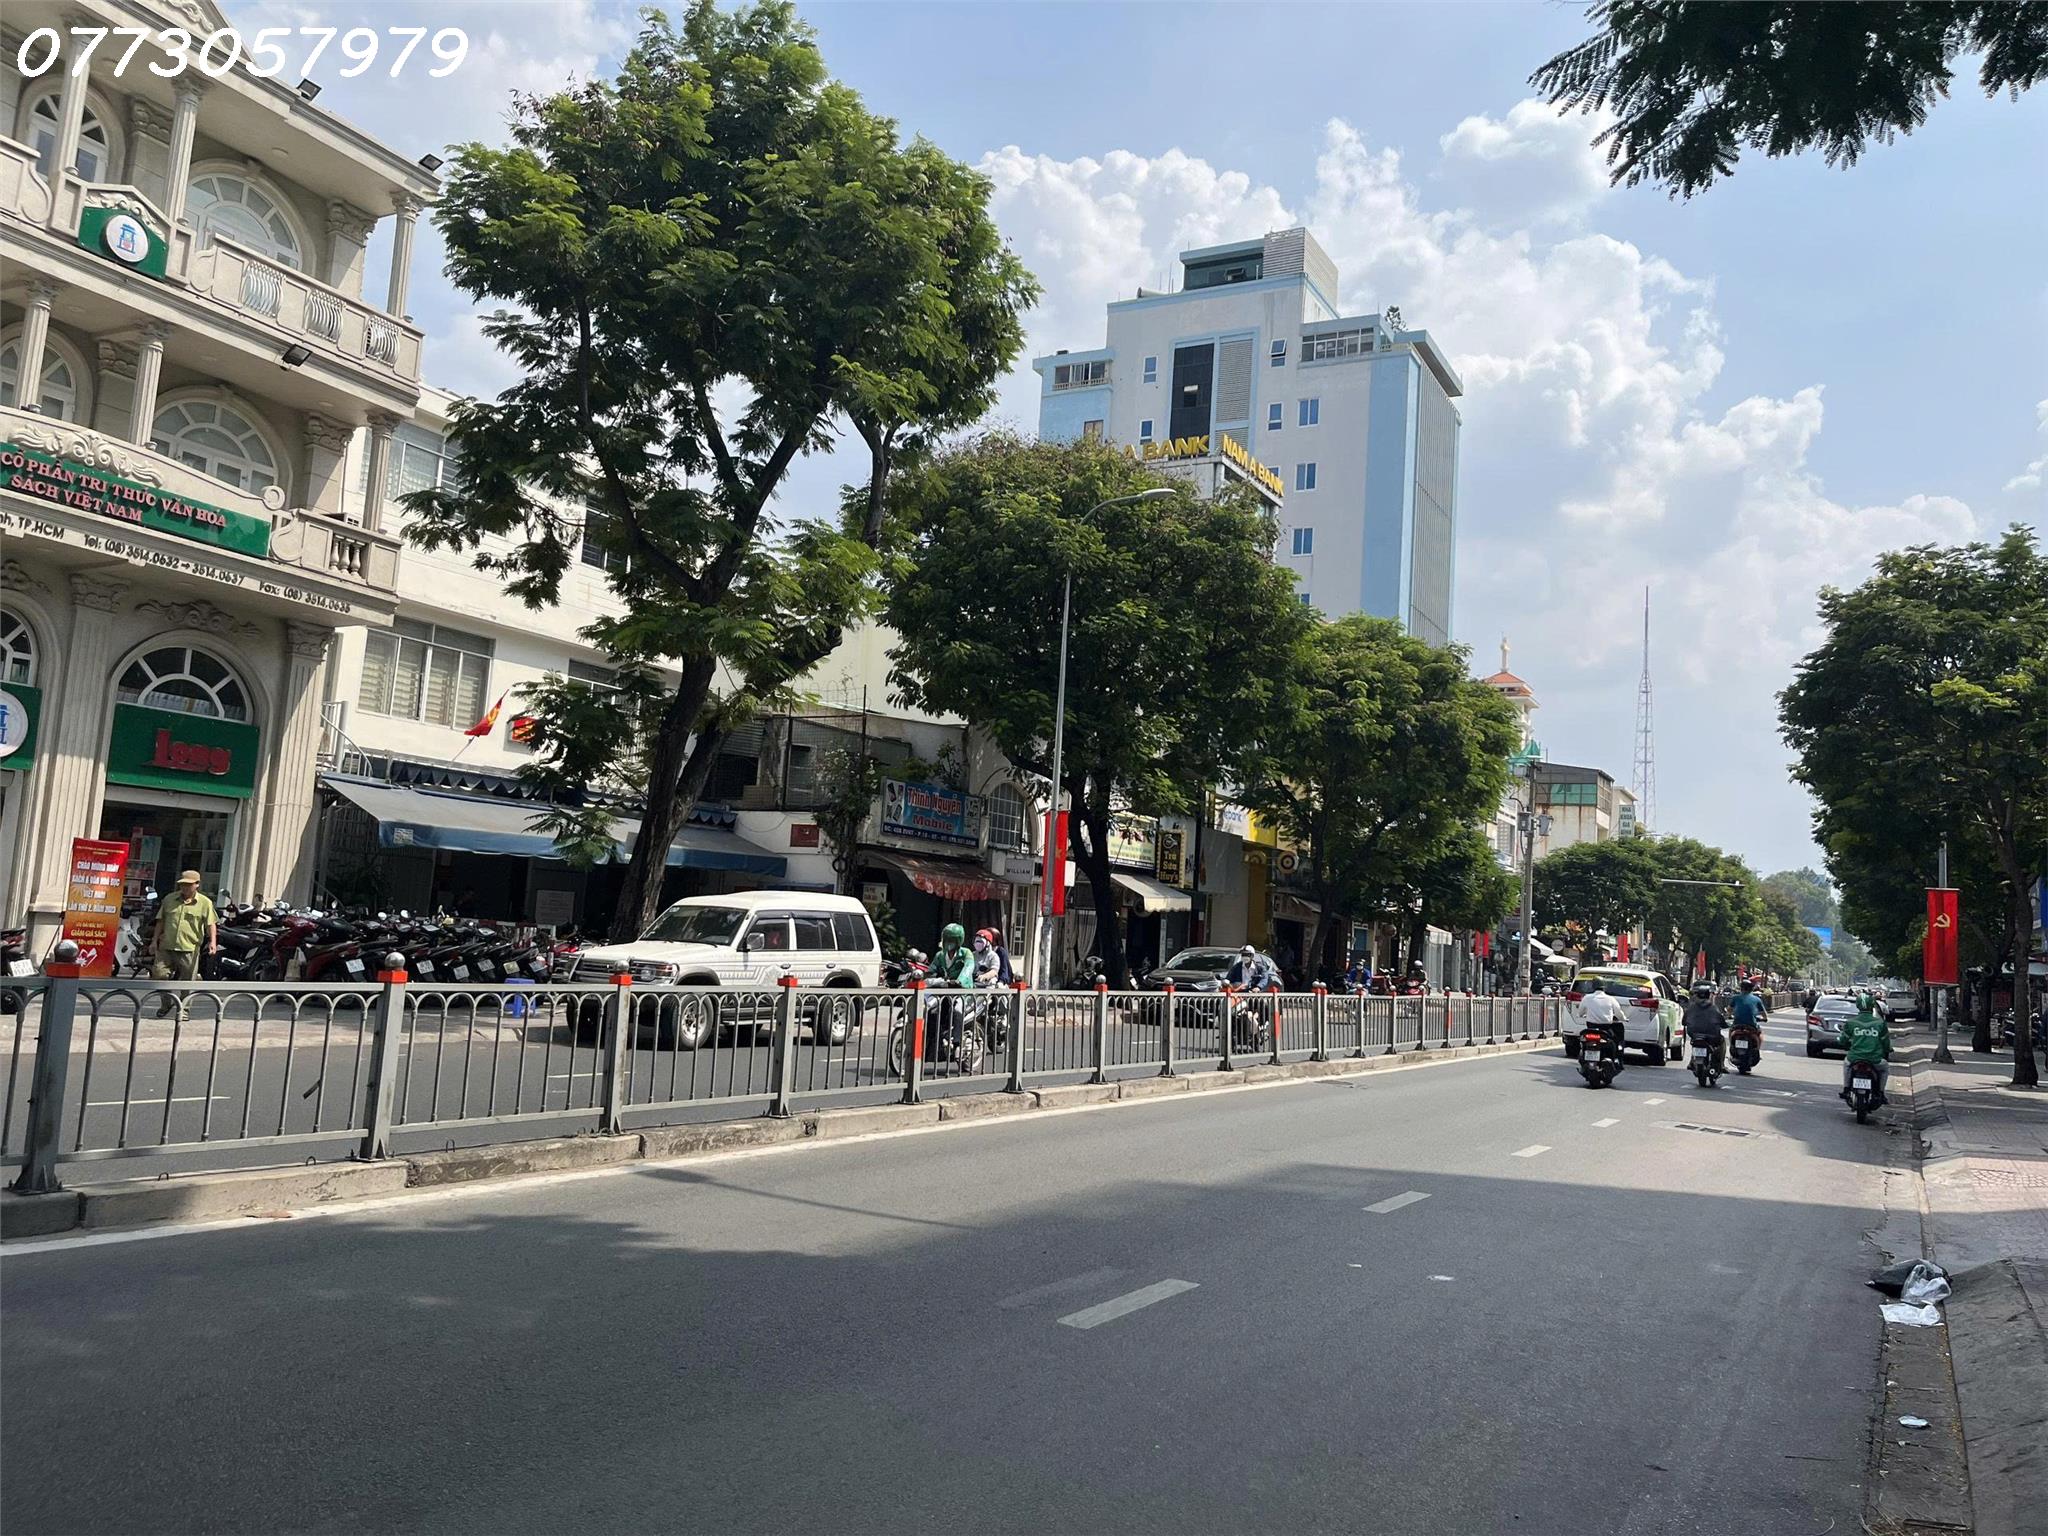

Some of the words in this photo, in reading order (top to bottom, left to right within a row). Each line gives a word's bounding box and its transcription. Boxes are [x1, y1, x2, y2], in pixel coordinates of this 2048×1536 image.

[1142, 435, 1209, 459] BANK
[1223, 433, 1249, 467] NAM
[1249, 460, 1257, 474] A
[1258, 463, 1285, 496] BANK
[12, 474, 60, 499] SÁCH
[64, 490, 103, 511] VIỆT
[106, 501, 143, 521] NAM
[27, 458, 76, 484] PHẦN
[80, 474, 108, 493] TRI
[112, 485, 156, 506] THỨC
[161, 497, 193, 517] VĂN
[19, 517, 65, 539] TP.HCM
[913, 814, 954, 832] Mobile
[1853, 1027, 1878, 1037] Grab
